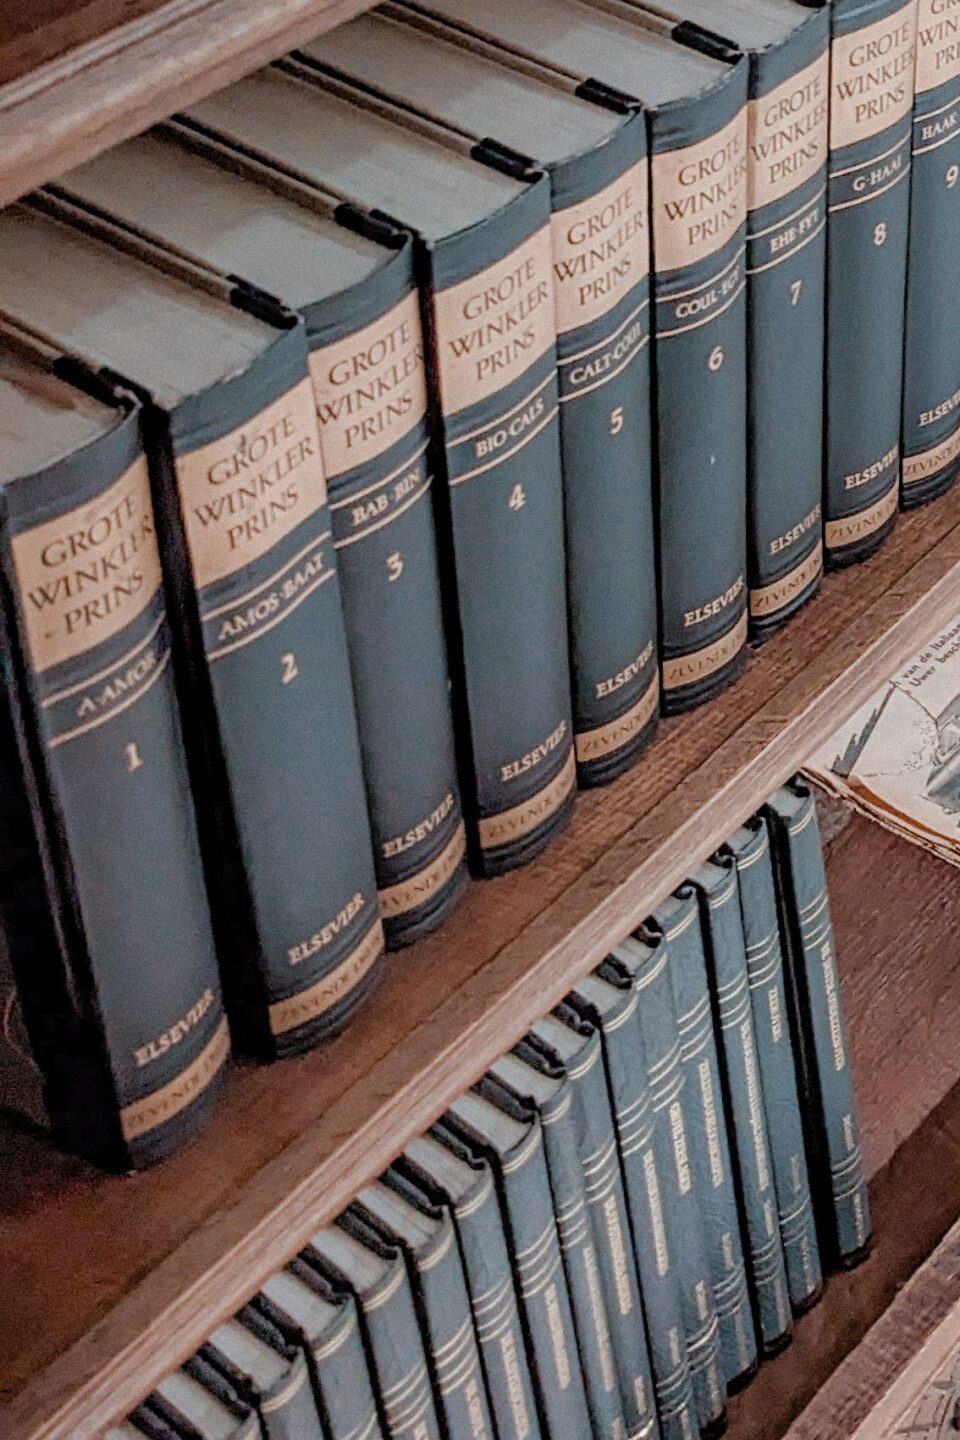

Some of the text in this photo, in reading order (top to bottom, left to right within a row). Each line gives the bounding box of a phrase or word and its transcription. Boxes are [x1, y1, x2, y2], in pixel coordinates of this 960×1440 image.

[848, 21, 910, 67] GROTE
[763, 78, 822, 127] GROTE
[854, 86, 905, 124] PRINS
[678, 136, 740, 187] GROTE
[769, 139, 819, 185] PRINS
[945, 165, 959, 188] 9
[566, 187, 632, 245] GROTE
[687, 202, 738, 246] PRINS
[873, 222, 887, 247] 8
[553, 211, 644, 282] WINKLER
[463, 257, 536, 321] GROTE
[579, 258, 632, 306] PRINS
[790, 280, 802, 306] 7
[449, 281, 549, 358] WINKLER
[328, 320, 412, 386] GROTE
[475, 324, 536, 380] PRINS
[708, 345, 724, 371] 6
[317, 344, 425, 425] WINKLER
[344, 389, 413, 448] PRINS
[610, 407, 624, 434] 5
[207, 413, 294, 485] GROTE
[194, 436, 315, 527] WINKLER
[508, 483, 525, 511] 4
[41, 495, 135, 568] GROTE
[226, 482, 298, 551] PRINS
[28, 512, 154, 611] WINKLER
[386, 551, 403, 581] 3
[64, 572, 143, 635] PRINS
[683, 575, 744, 627] ELSEVIER
[280, 653, 298, 684] 2
[596, 639, 654, 698] ELSEVIER
[902, 665, 920, 678] van
[918, 652, 932, 663] de
[909, 665, 936, 687] Uwer
[126, 742, 142, 772] 1
[501, 720, 567, 782] ELSEVIER
[383, 793, 454, 858] ELSEVIER
[288, 893, 365, 966] ELSEVIER
[135, 988, 214, 1067] ELSEVIER
